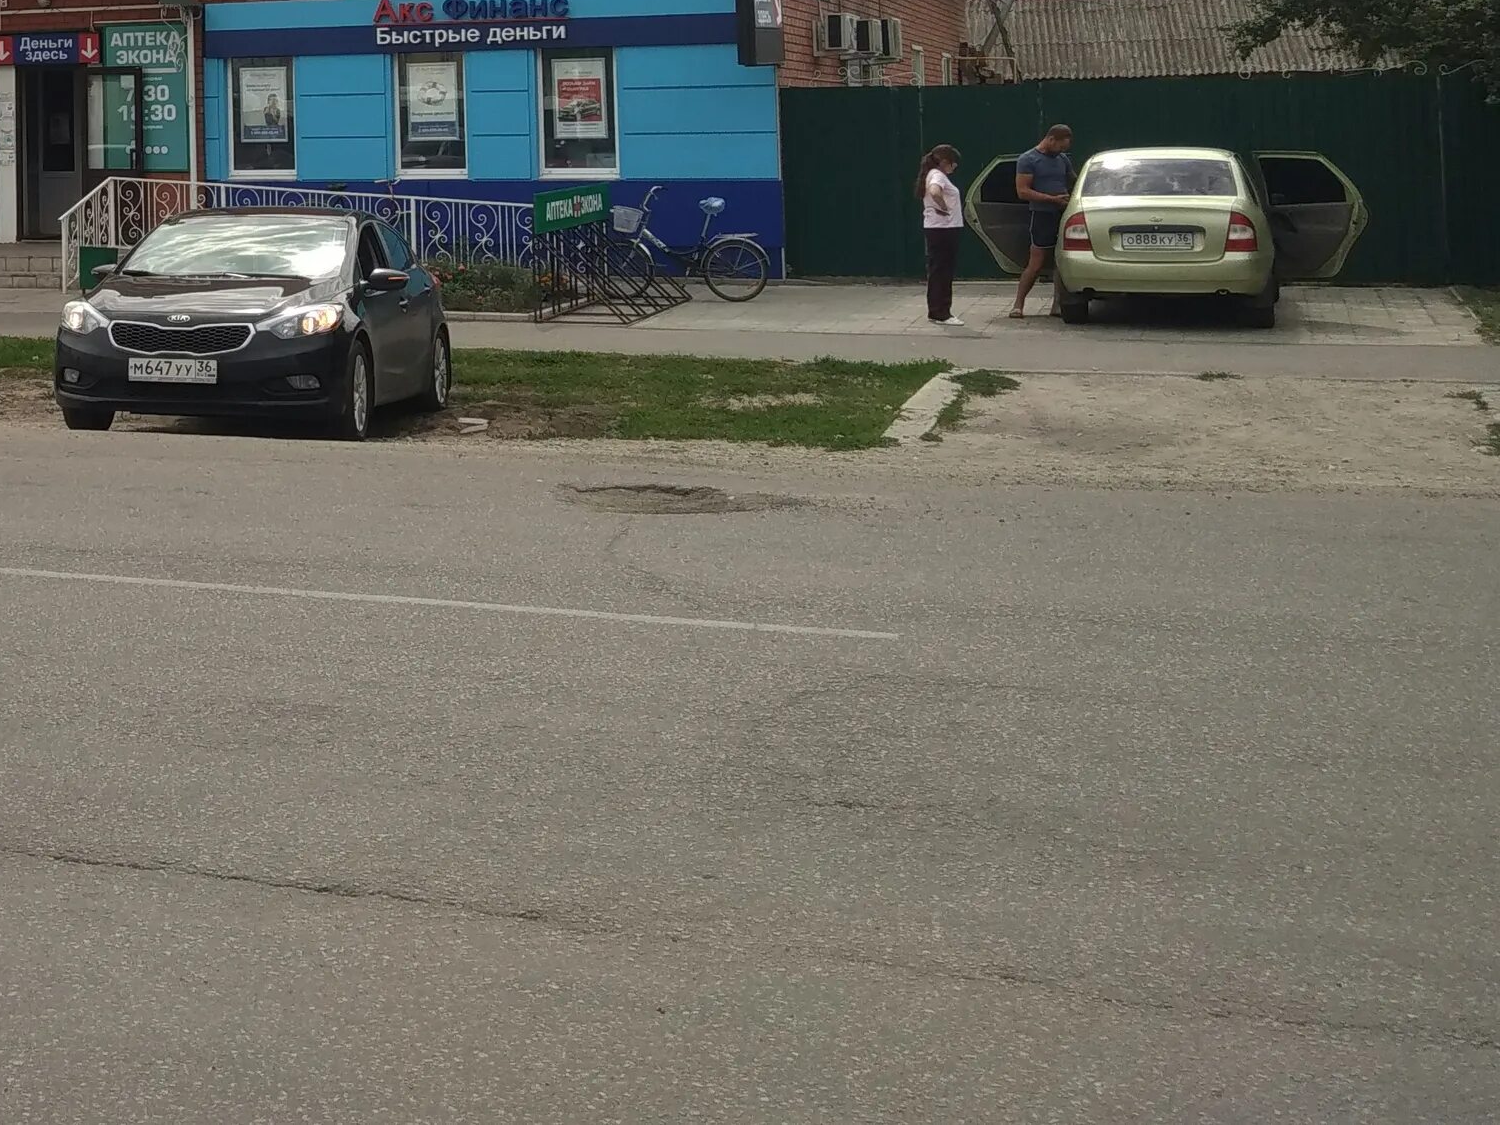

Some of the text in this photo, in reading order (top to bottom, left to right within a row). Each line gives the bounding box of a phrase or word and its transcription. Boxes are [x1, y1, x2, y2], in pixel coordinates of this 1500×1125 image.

[19, 37, 73, 51] Деньги
[110, 30, 180, 47] АПТЕКА
[376, 24, 567, 48] Быстрые деньги
[25, 49, 68, 62] здесь
[115, 49, 177, 65] ЭКОНА
[546, 193, 603, 222] АПТЕКА ЭКОНА
[1126, 233, 1189, 245] О888КУ 36
[133, 360, 212, 376] М647УУ 36
